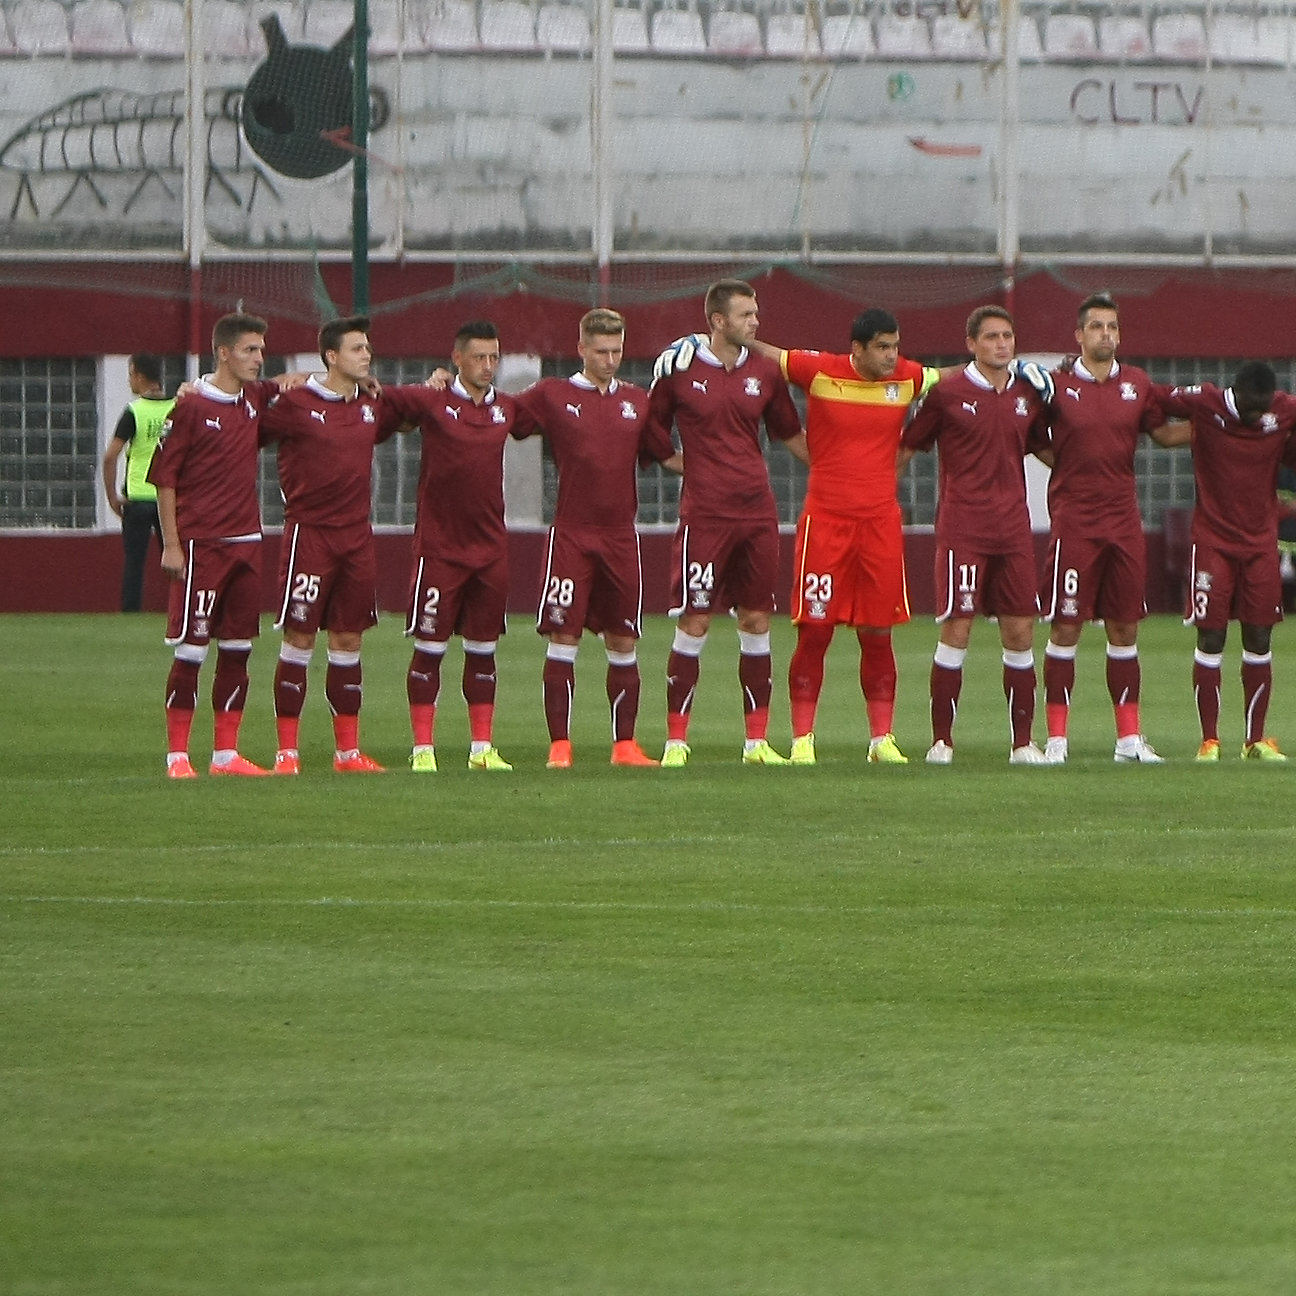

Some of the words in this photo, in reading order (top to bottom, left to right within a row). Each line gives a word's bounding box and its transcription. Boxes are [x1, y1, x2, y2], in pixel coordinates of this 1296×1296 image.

[1070, 78, 1204, 125] CLTV
[291, 572, 321, 604] 25
[688, 560, 716, 591] 24
[804, 572, 833, 602] 23
[957, 563, 978, 592] 11
[1064, 567, 1079, 597] 6
[194, 589, 217, 618] 17
[424, 586, 441, 615] 2
[547, 575, 574, 607] 28
